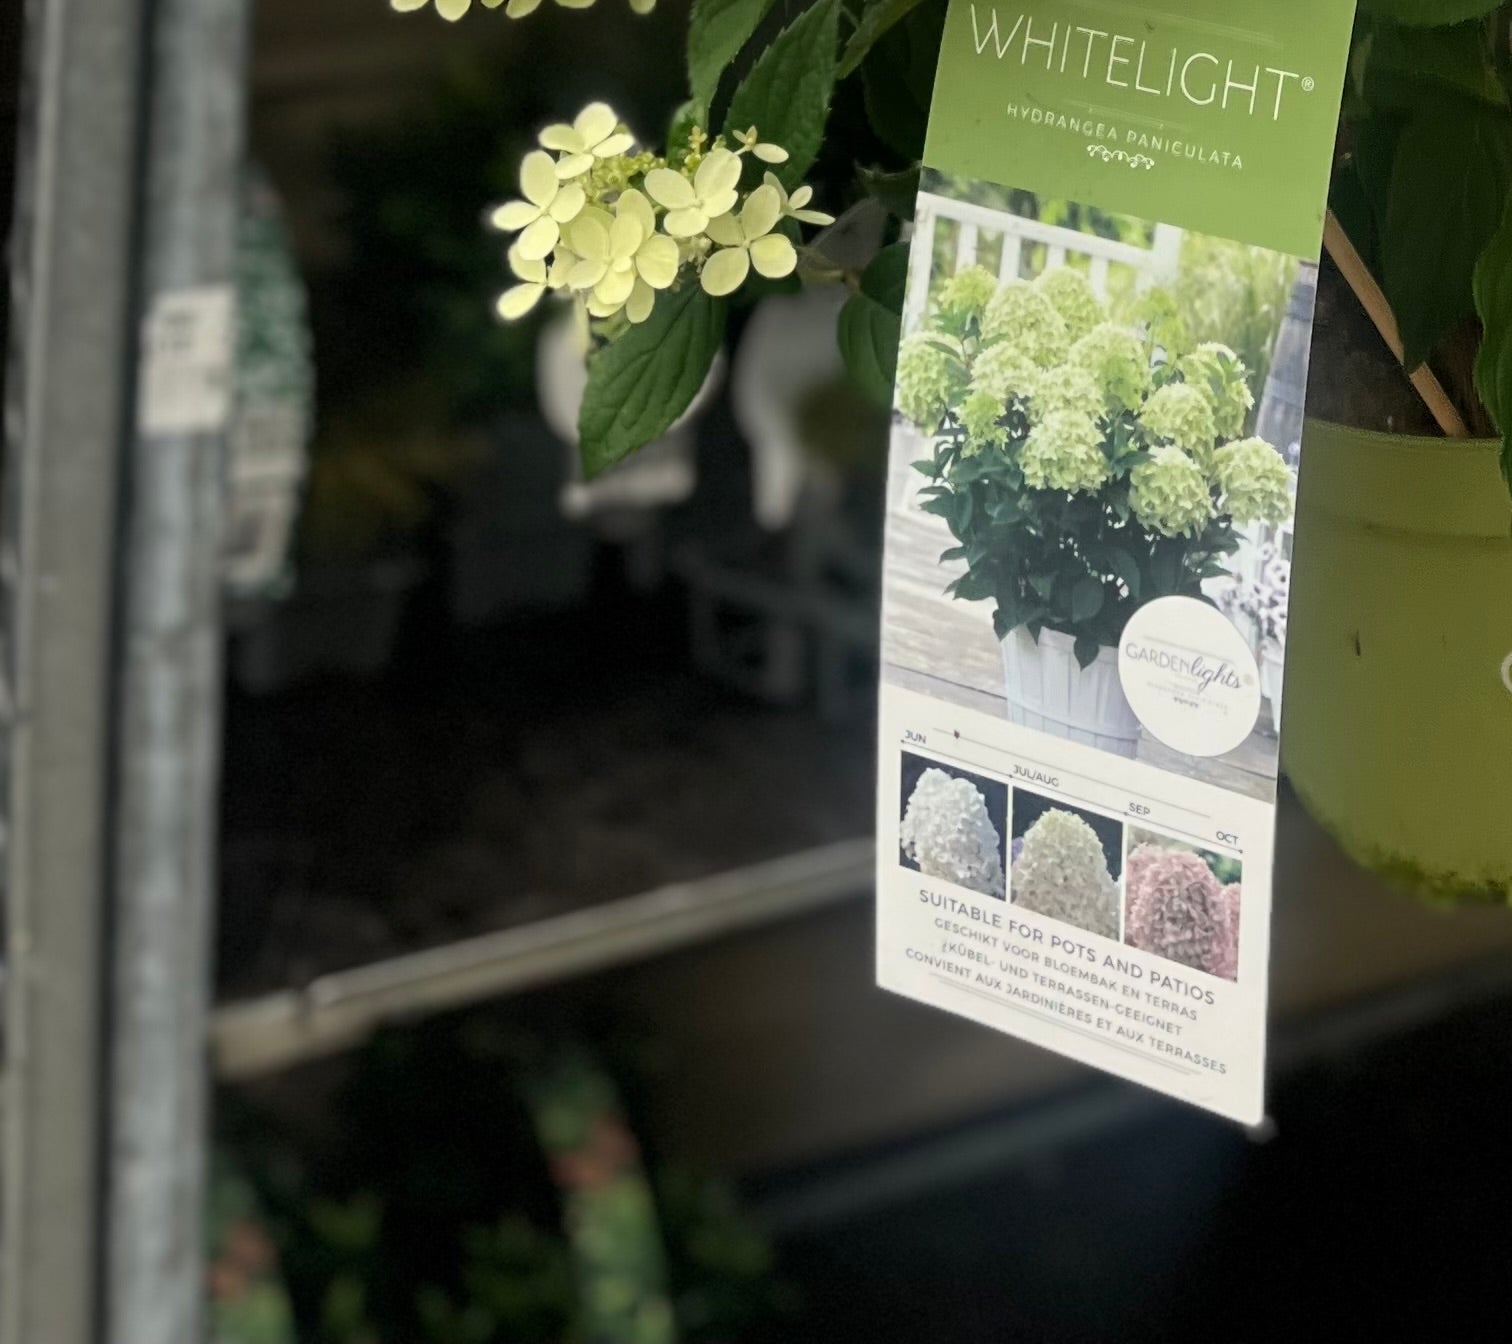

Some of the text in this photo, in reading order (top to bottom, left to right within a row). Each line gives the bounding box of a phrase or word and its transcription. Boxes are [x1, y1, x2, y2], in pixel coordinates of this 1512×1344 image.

[1007, 103, 1242, 169] HYDRANGEA PANICULATA
[904, 729, 927, 745] JUN
[1013, 764, 1059, 788] JUL/AUG
[1129, 802, 1151, 816] SEP
[1215, 830, 1239, 846] OCT
[919, 889, 1215, 1005] SUITABLE FOR POTS AND PATIOS
[934, 918, 1198, 1021] GESCHIKT VOOR BLOEMBAK EN TERRAS
[999, 960, 1029, 979] UND
[905, 948, 973, 978] CONVIENT
[975, 973, 1003, 991] AUX
[1096, 1017, 1113, 1031] ET
[1116, 1025, 1145, 1043] AUX
[1149, 1036, 1227, 1075] TERRASSES
